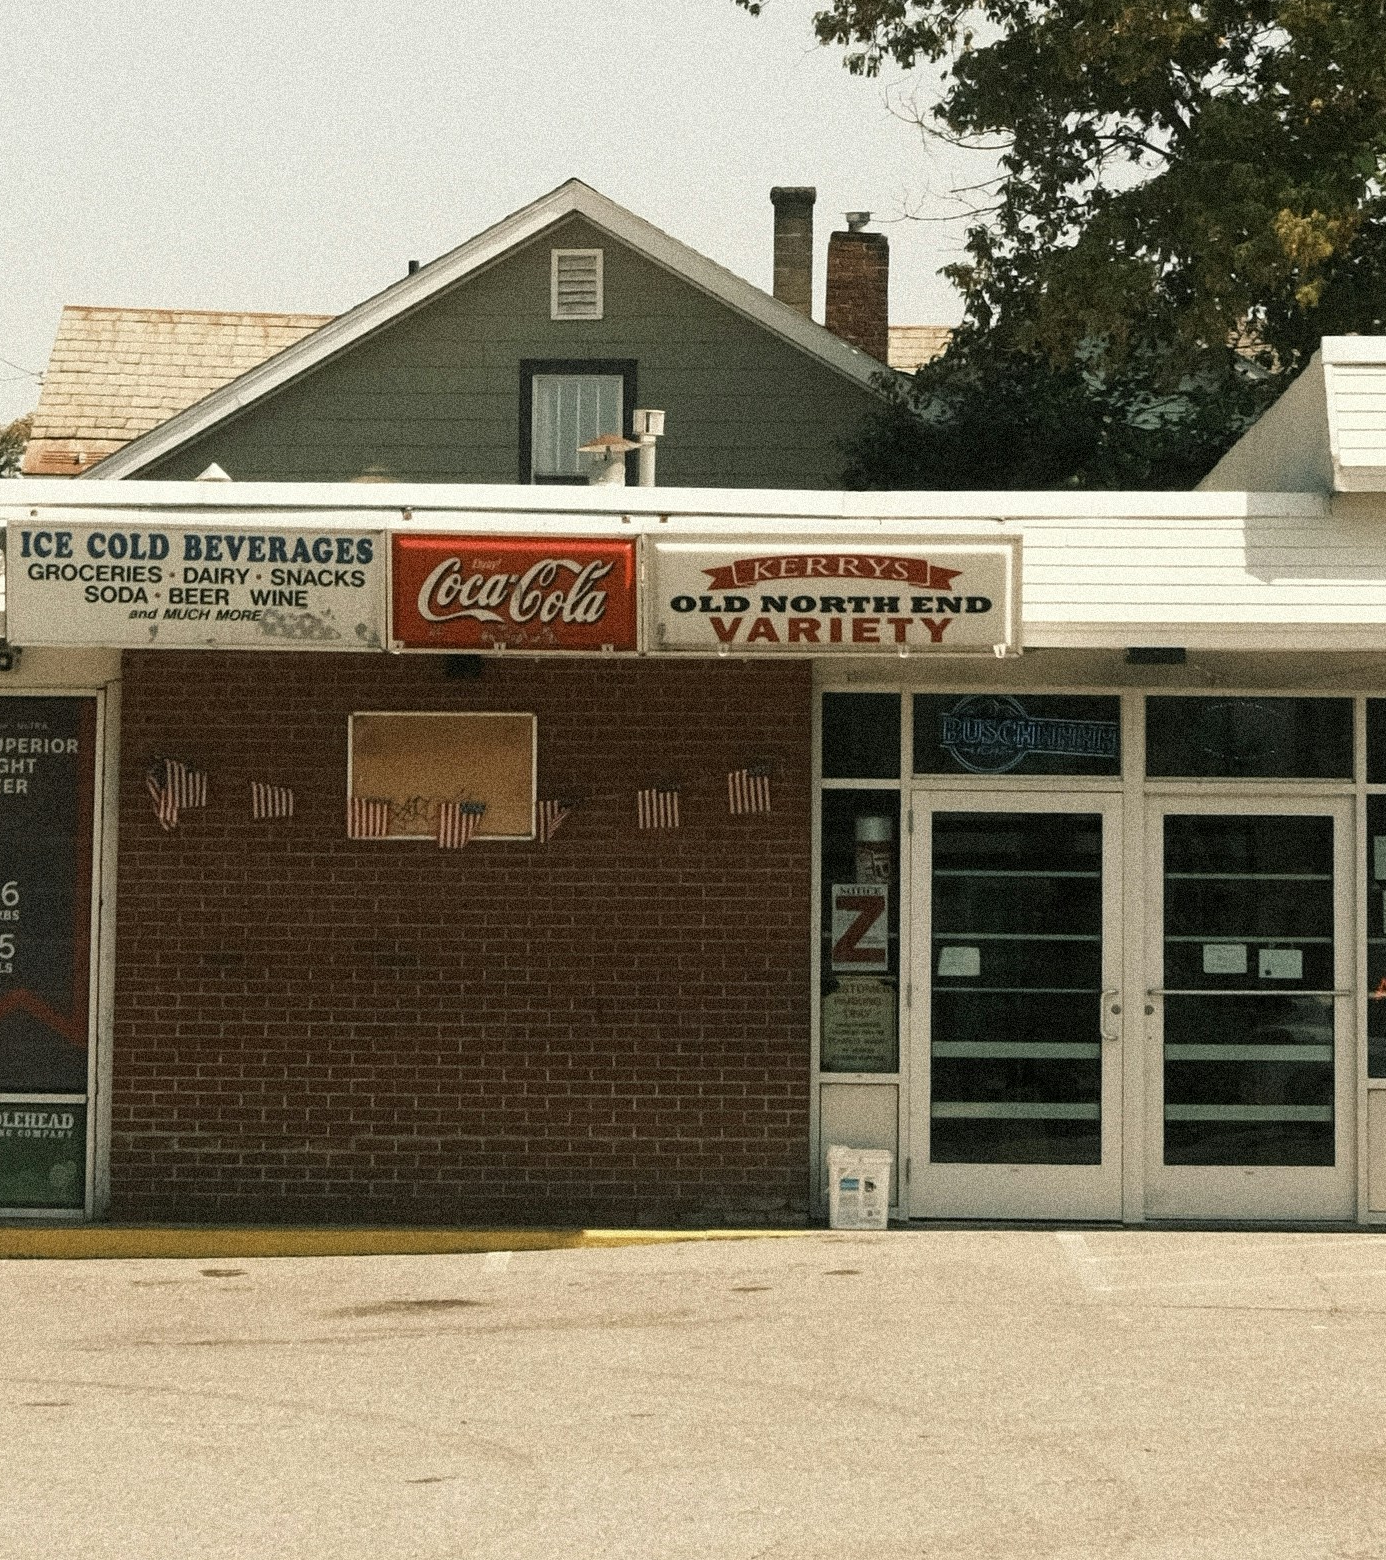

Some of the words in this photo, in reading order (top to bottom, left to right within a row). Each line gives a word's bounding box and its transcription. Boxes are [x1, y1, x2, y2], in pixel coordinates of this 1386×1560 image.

[20, 530, 73, 559] ICE
[86, 532, 170, 561] COLD
[183, 534, 374, 565] BEVERAGES
[27, 563, 163, 583] GROCERIES
[183, 567, 250, 586] DAIRY
[270, 568, 366, 588] SNACKS
[753, 556, 910, 580] KERRYS
[84, 586, 149, 604] SODA
[169, 587, 229, 606] BEER
[250, 589, 308, 607] WINE
[418, 556, 614, 623] Coca-Cola
[128, 608, 158, 620] and
[163, 608, 210, 621] MUCH
[215, 609, 263, 622] MORE
[670, 595, 751, 614] OLD
[760, 595, 900, 614] NORTH
[910, 596, 993, 614] END
[709, 617, 953, 643] VARIETY
[17, 1129, 74, 1138] COMPANY
